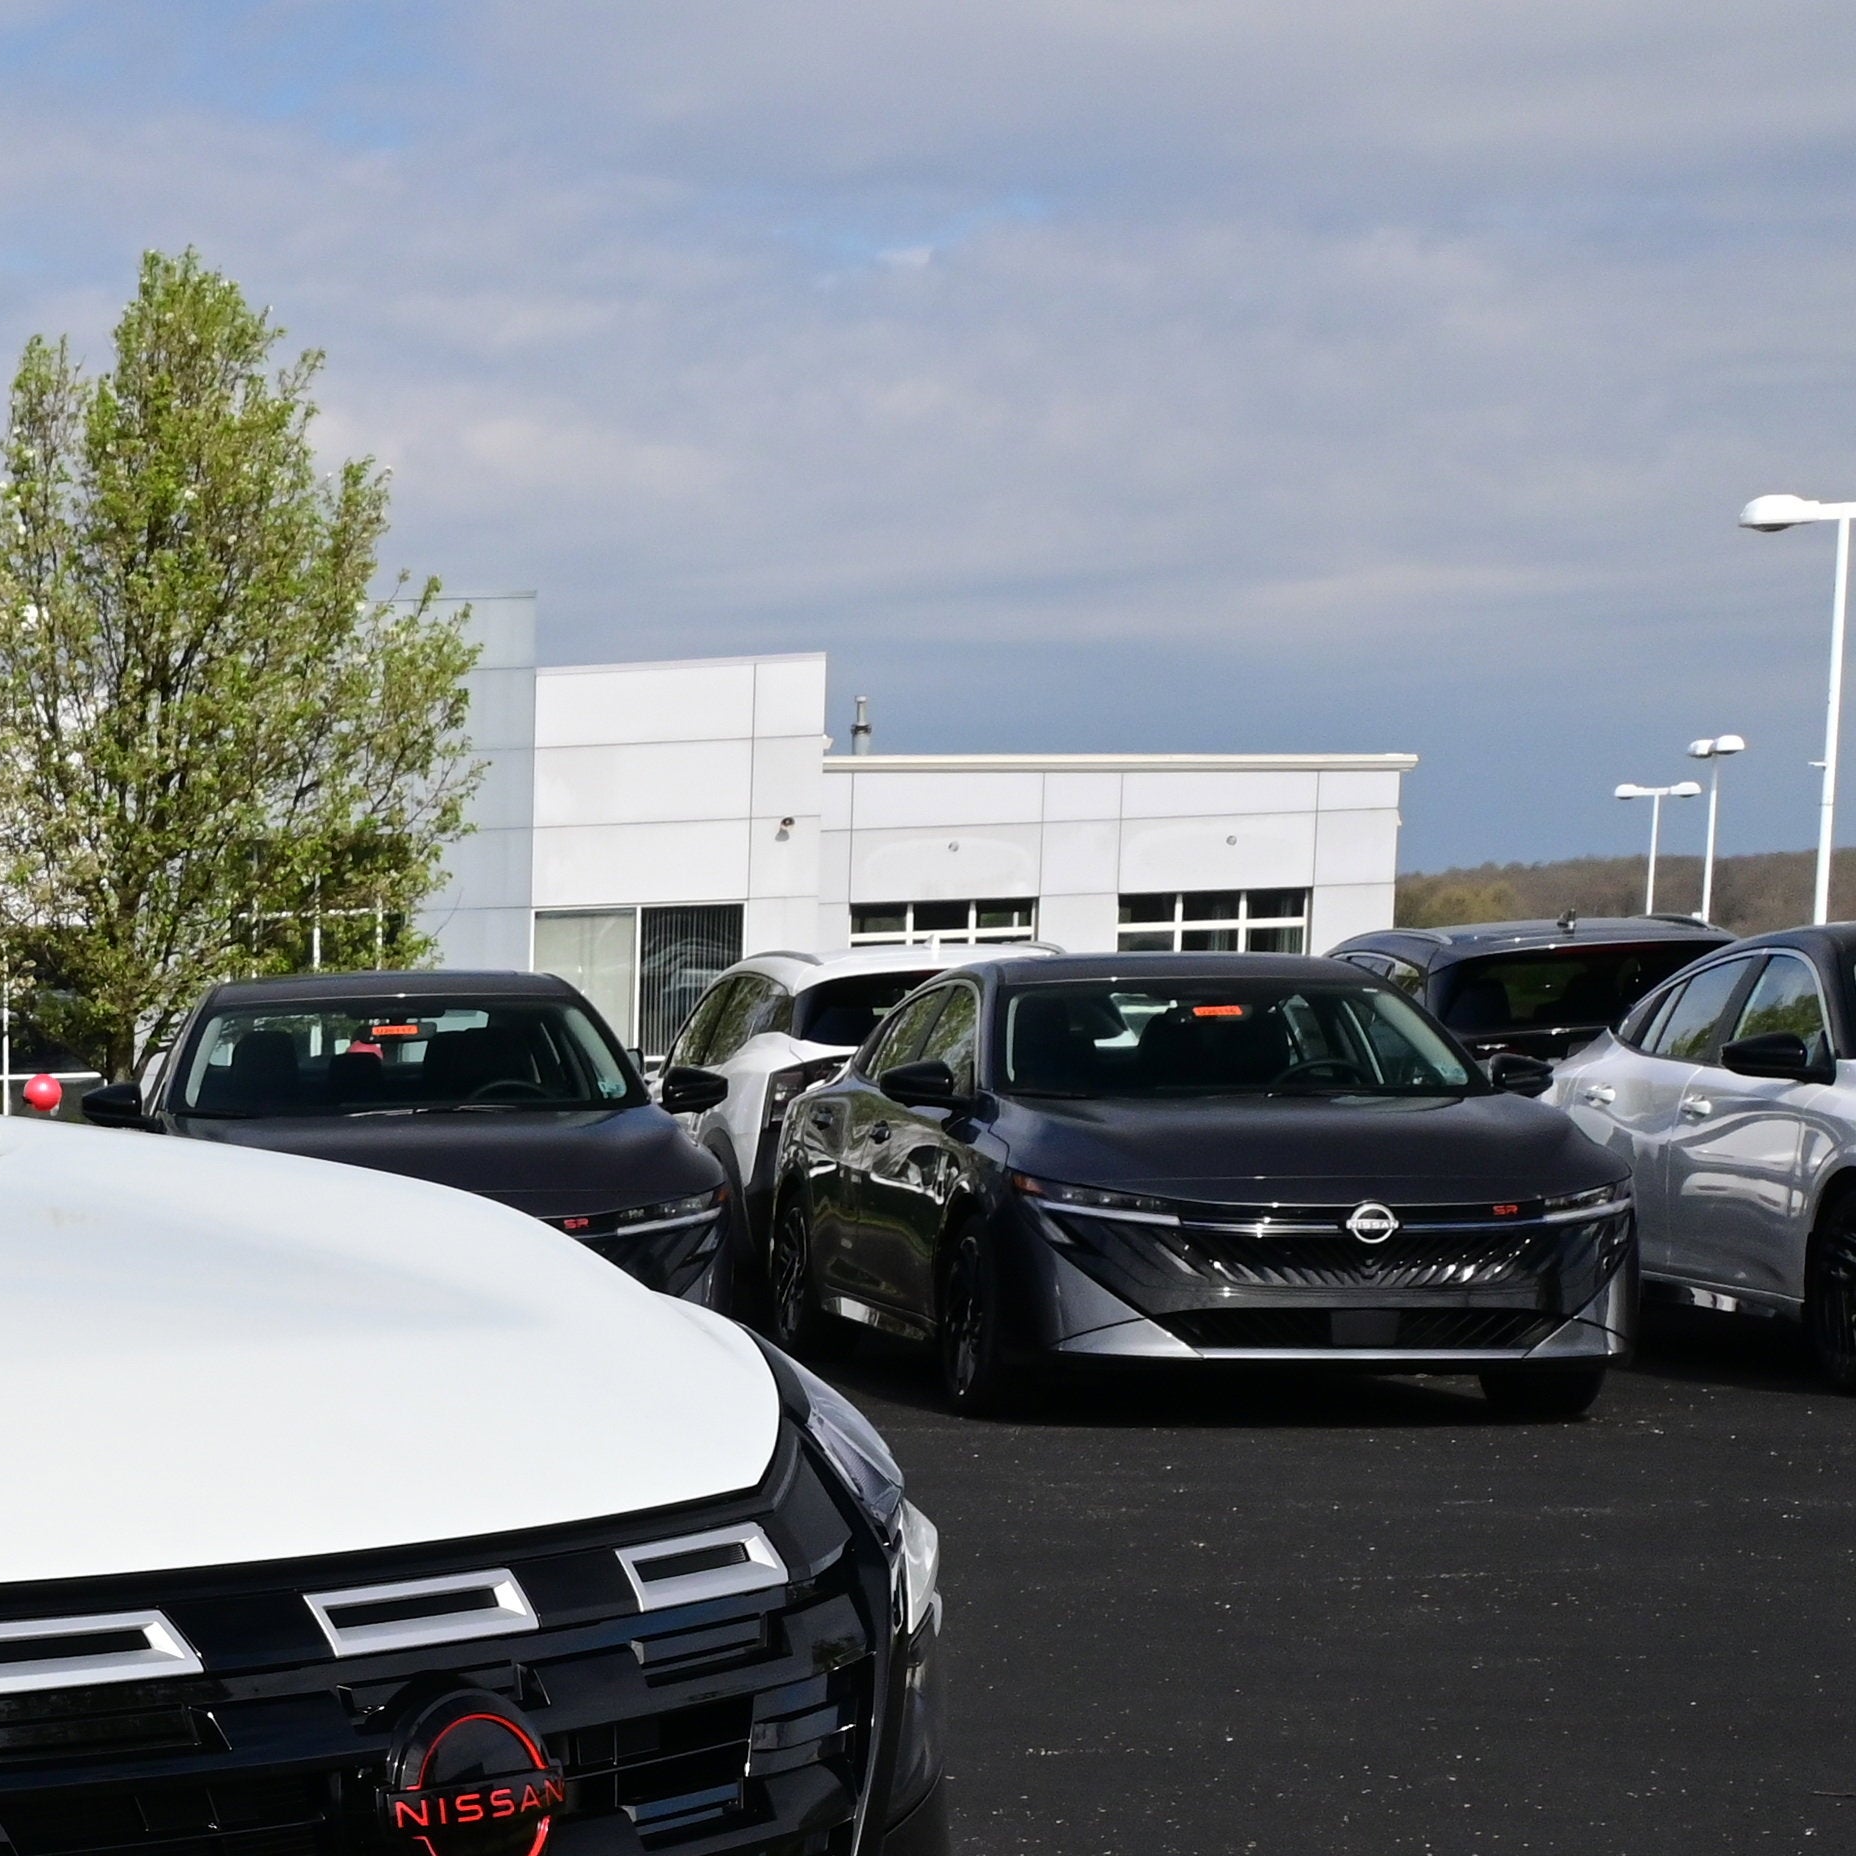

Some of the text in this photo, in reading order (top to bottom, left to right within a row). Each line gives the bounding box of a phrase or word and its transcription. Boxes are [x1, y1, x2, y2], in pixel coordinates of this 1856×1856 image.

[1492, 1205, 1518, 1216] SR
[563, 1218, 589, 1229] SR
[1346, 1219, 1399, 1230] NISSAN
[394, 1776, 566, 1829] NISSAN
